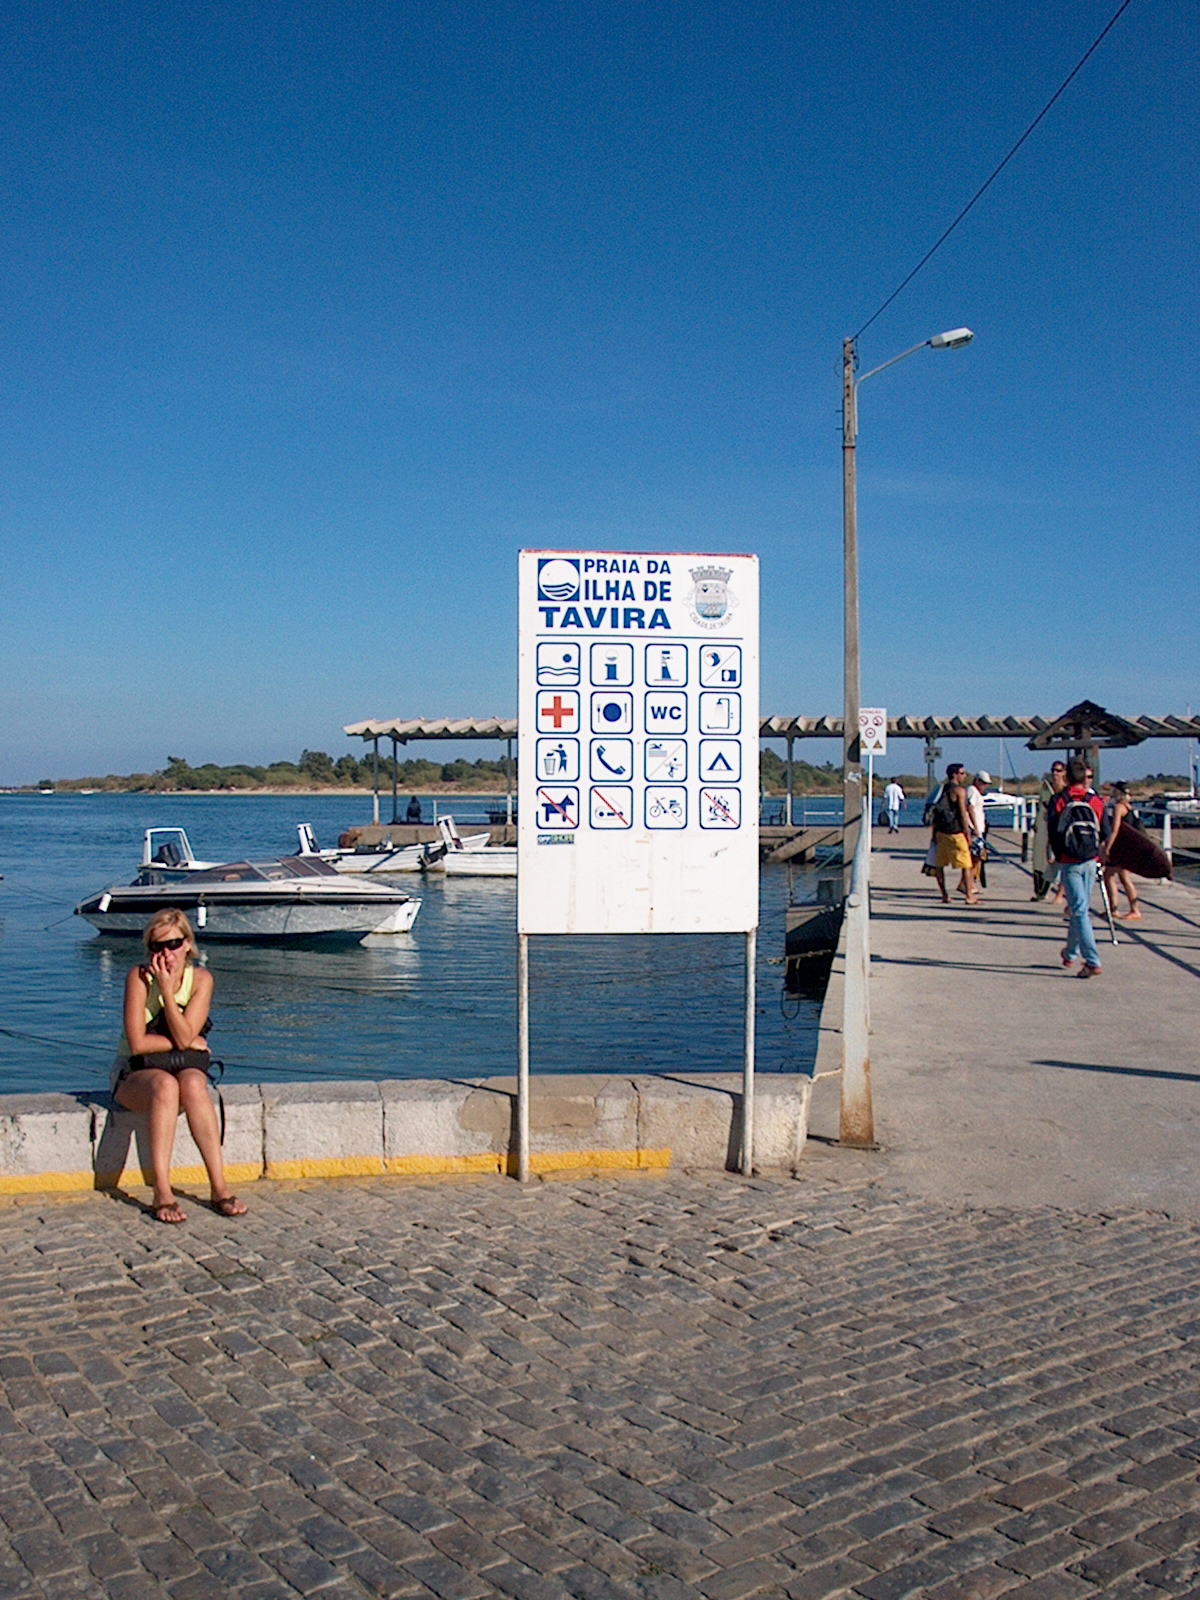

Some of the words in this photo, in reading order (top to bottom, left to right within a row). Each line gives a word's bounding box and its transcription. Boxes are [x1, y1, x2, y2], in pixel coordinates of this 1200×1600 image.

[584, 559, 640, 573] PRAIA
[647, 560, 671, 574] DA
[585, 579, 636, 600] ILHA
[644, 580, 672, 601] DE
[538, 606, 672, 629] TAVIRA
[651, 706, 682, 720] WC
